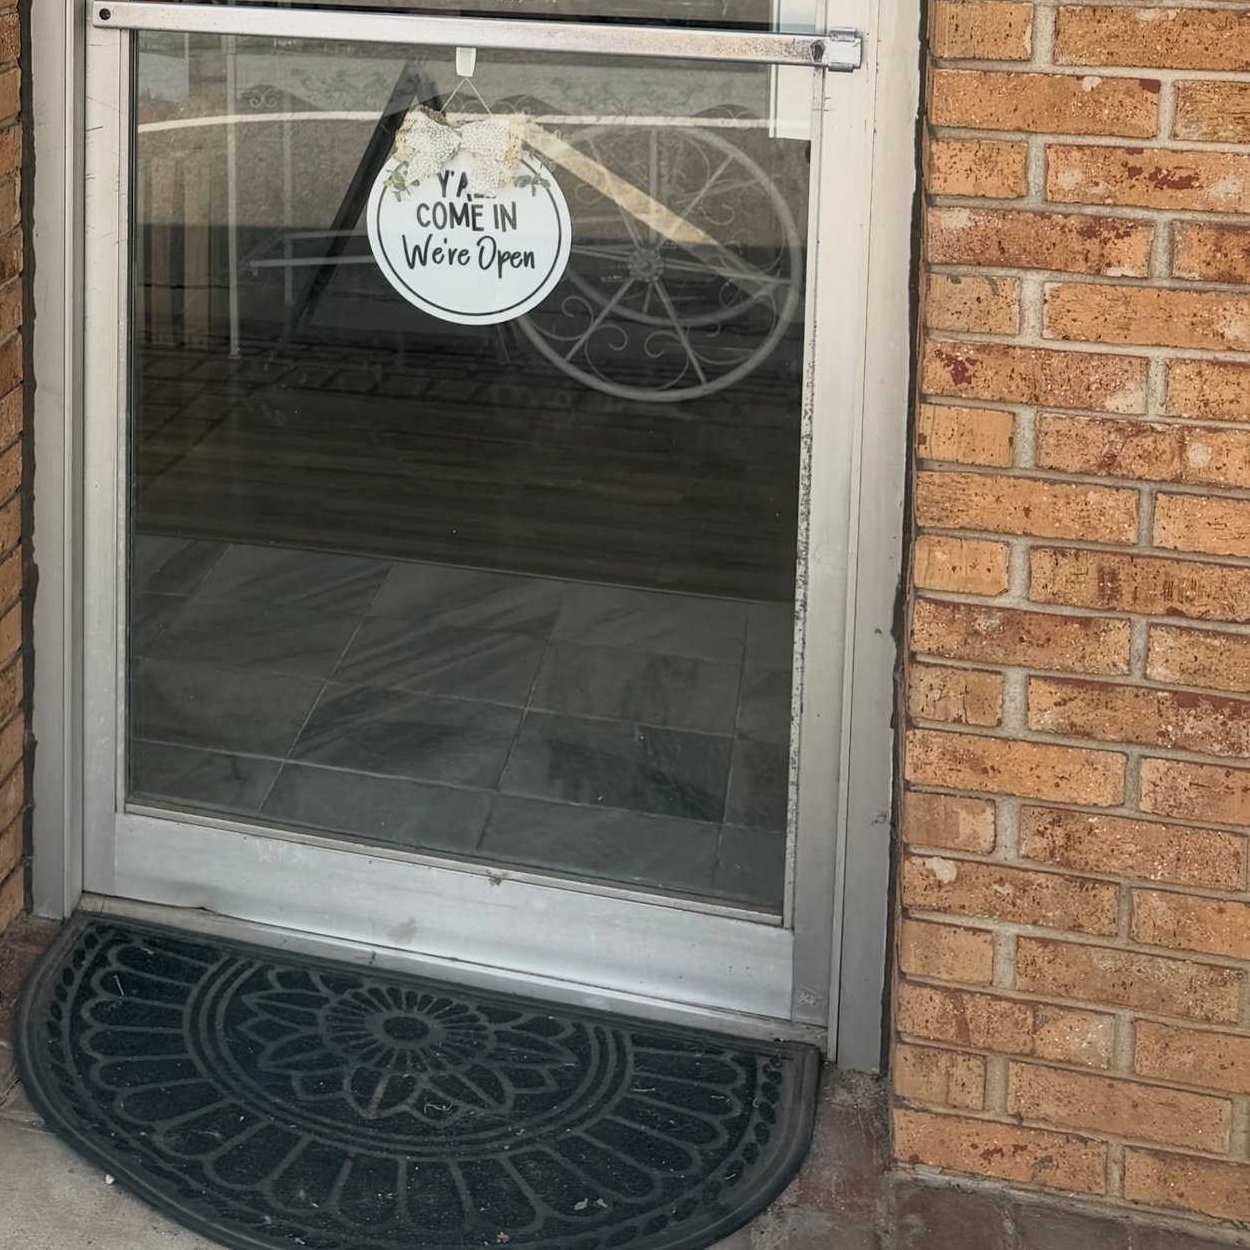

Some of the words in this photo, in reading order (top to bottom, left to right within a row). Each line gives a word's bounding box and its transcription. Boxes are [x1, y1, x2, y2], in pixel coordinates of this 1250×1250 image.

[437, 169, 497, 202] Y'A
[416, 201, 485, 232] COME
[493, 201, 518, 233] IN
[401, 233, 472, 270] We're
[476, 235, 536, 279] Open
